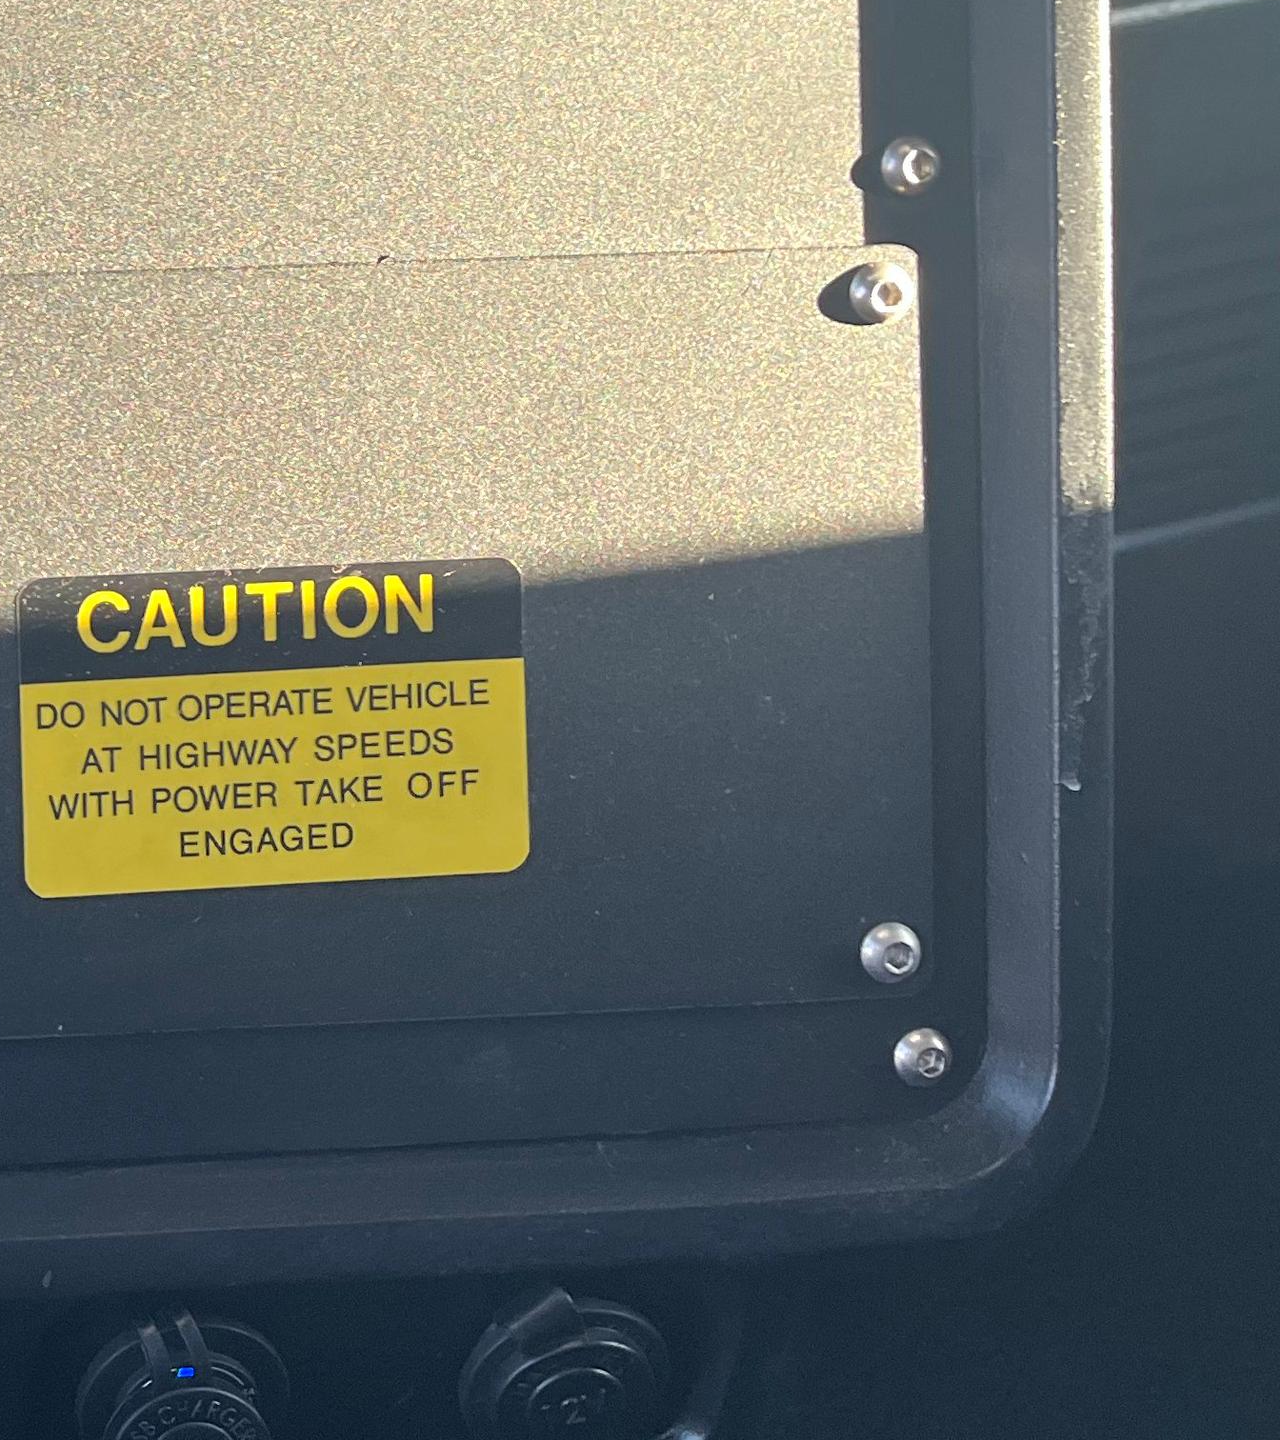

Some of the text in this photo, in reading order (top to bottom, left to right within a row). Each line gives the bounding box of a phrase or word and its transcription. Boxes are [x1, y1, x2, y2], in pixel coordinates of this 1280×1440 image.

[76, 572, 435, 654] CAUTION
[36, 678, 490, 730] DO NOT OPERATE VEHICLE
[81, 728, 454, 775] AT HIGHWAY SPEEDS
[48, 769, 480, 820] WITH POWER TAKE OFF
[179, 822, 354, 859] ENGAGED
